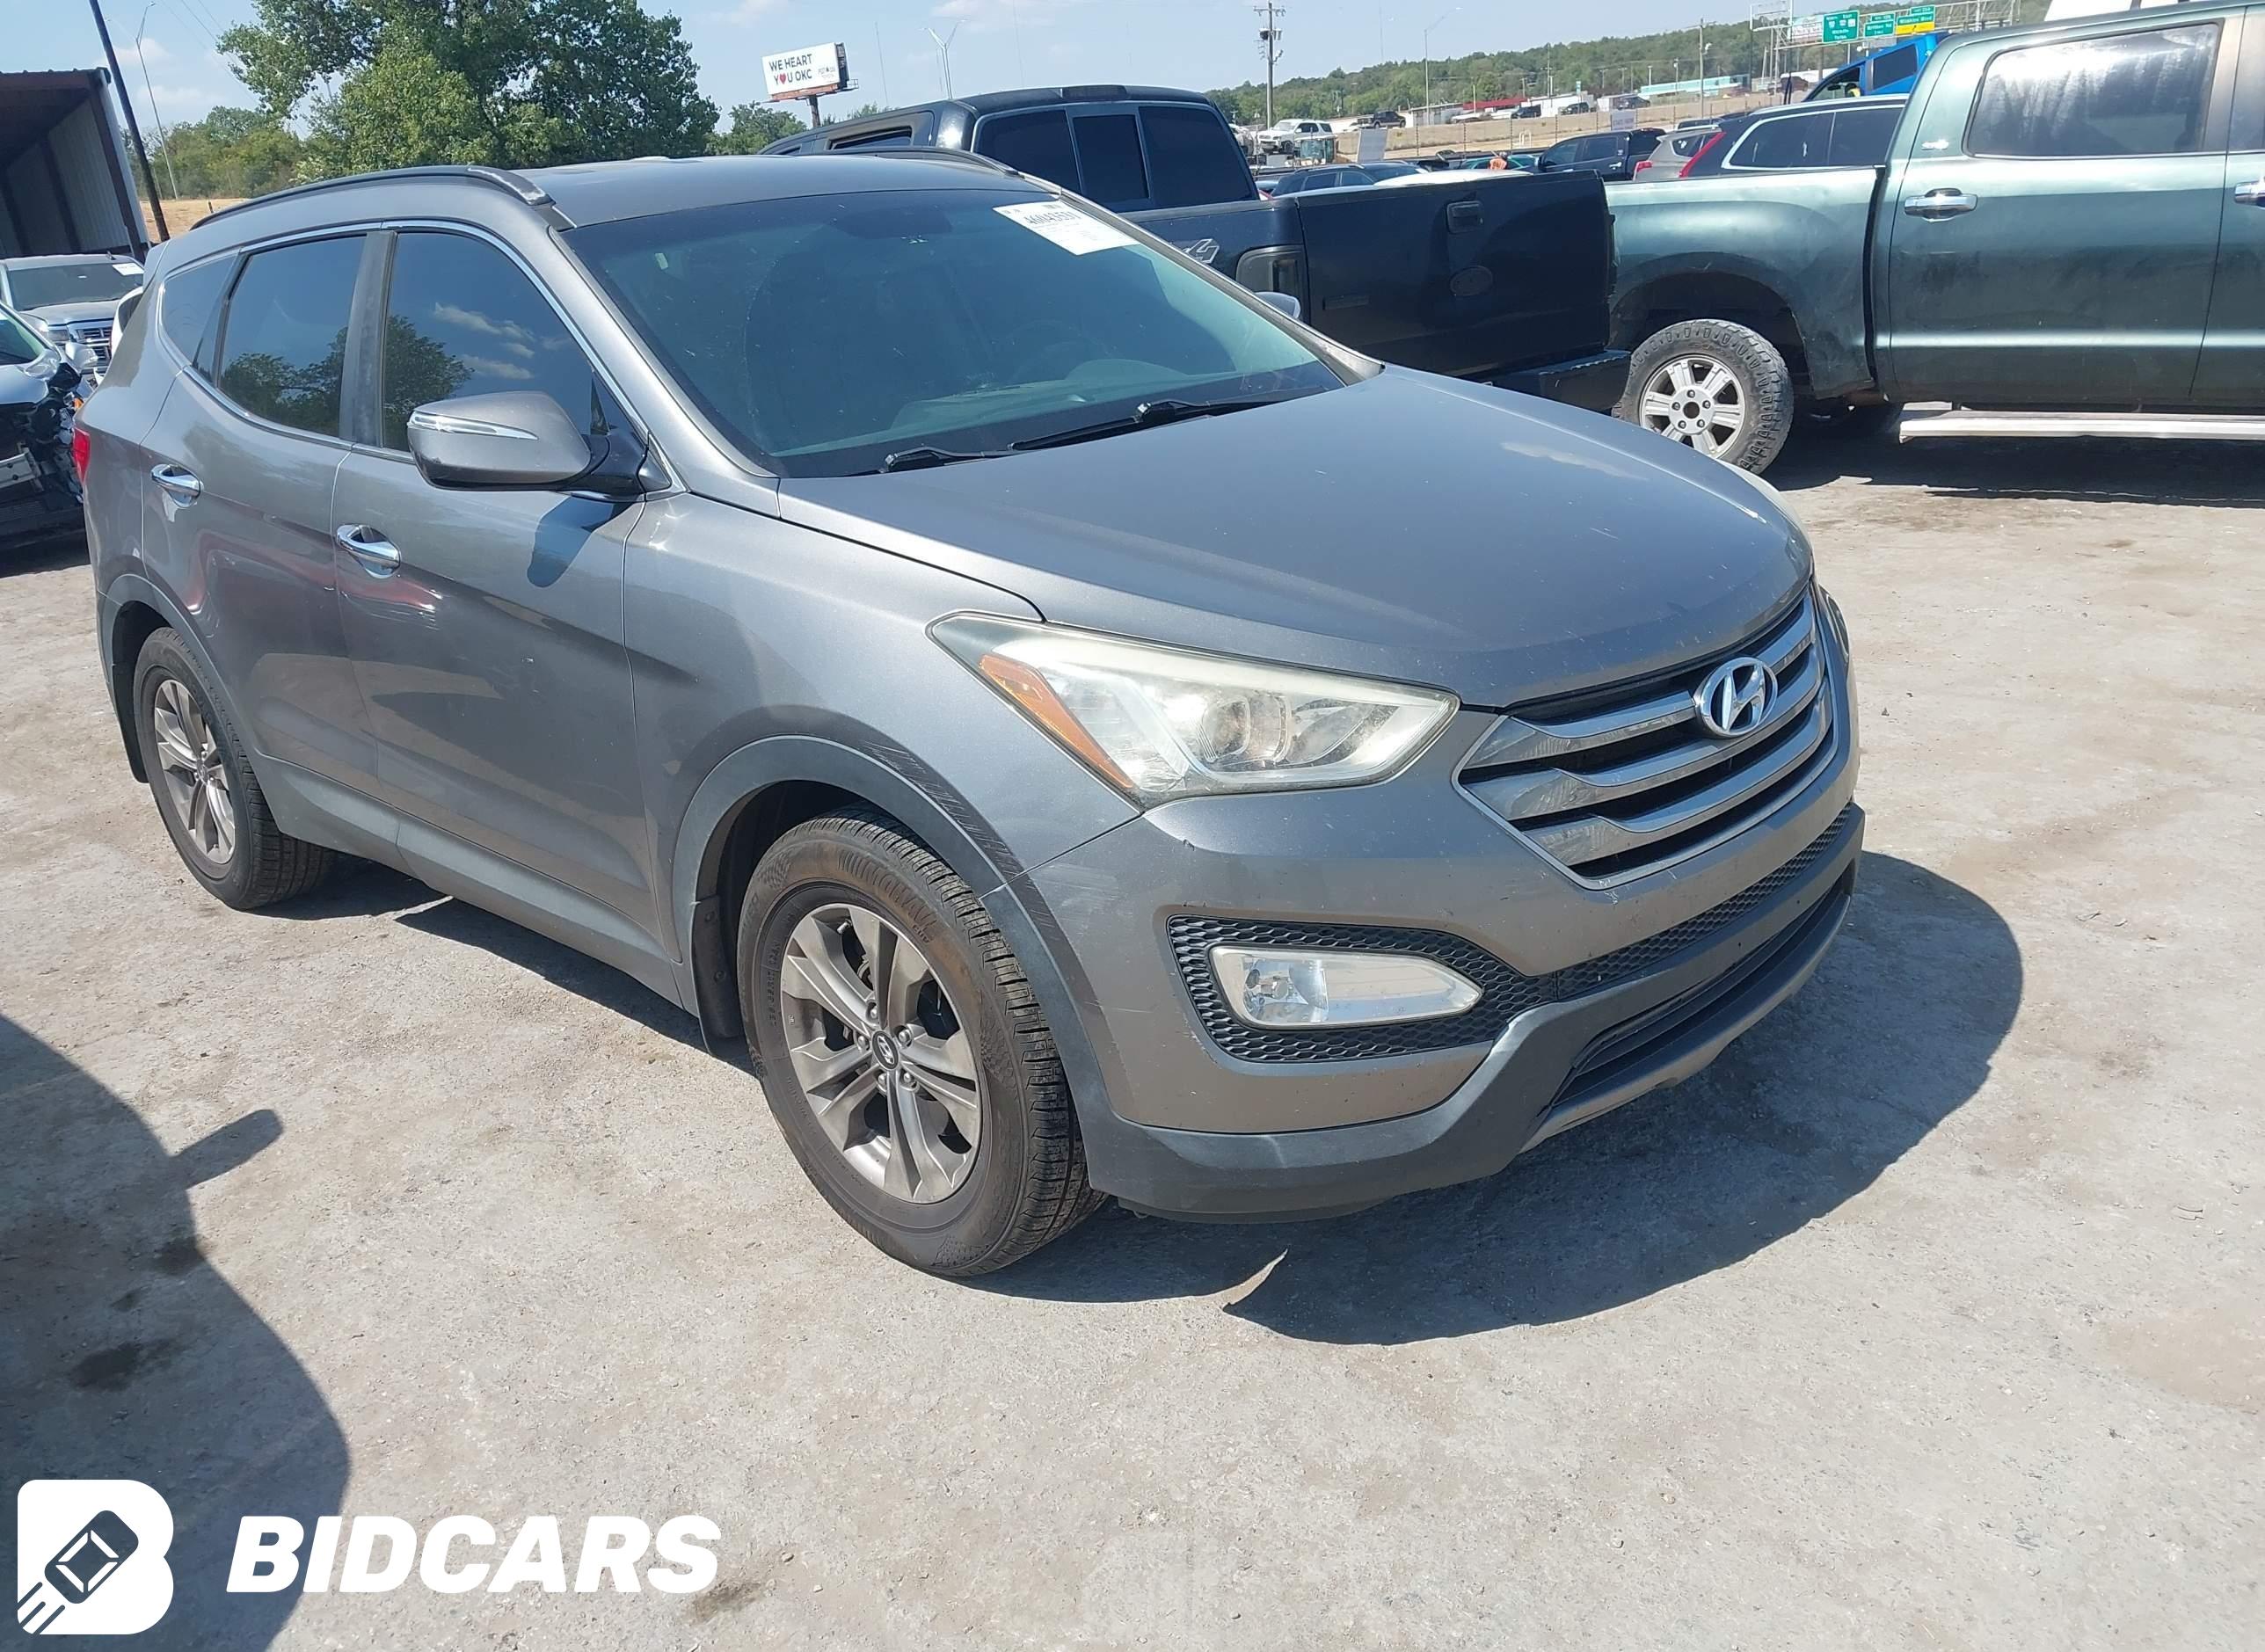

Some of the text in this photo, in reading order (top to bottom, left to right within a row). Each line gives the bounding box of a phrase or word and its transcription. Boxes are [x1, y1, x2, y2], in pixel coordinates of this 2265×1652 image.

[768, 54, 812, 71] WE HEART
[774, 72, 793, 84] YU
[795, 69, 812, 81] OKC
